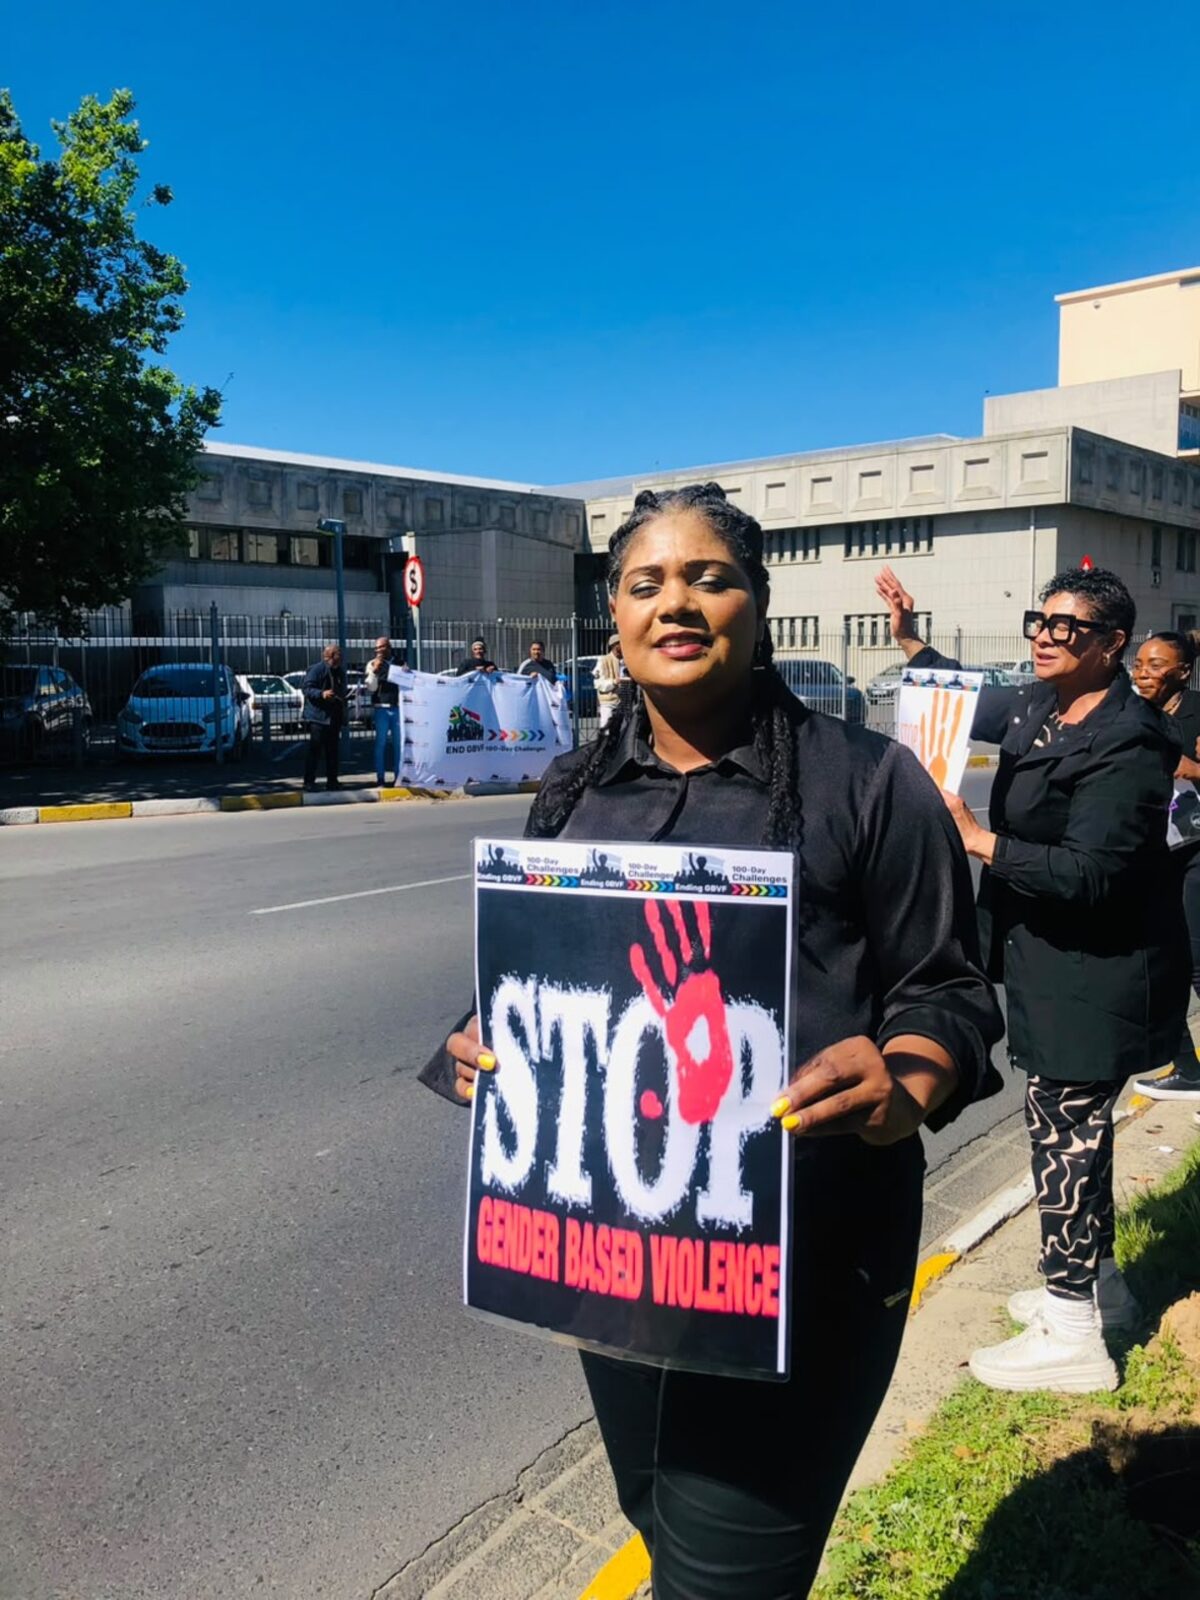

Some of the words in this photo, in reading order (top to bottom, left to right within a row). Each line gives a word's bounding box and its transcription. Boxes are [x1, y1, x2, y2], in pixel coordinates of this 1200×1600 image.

[446, 745, 465, 754] END
[527, 857, 559, 865] 100-Day
[527, 864, 579, 874] Challenges
[629, 863, 658, 871] 100-Day
[732, 866, 766, 875] 100-Day
[732, 873, 788, 884] Challenges
[581, 879, 604, 888] Ending
[675, 883, 703, 893] Ending
[705, 884, 727, 893] GBVF
[480, 971, 786, 1232] STOP
[477, 1196, 559, 1283] GENDER
[565, 1217, 643, 1299] BASED
[650, 1233, 780, 1318] VIOLENCE
